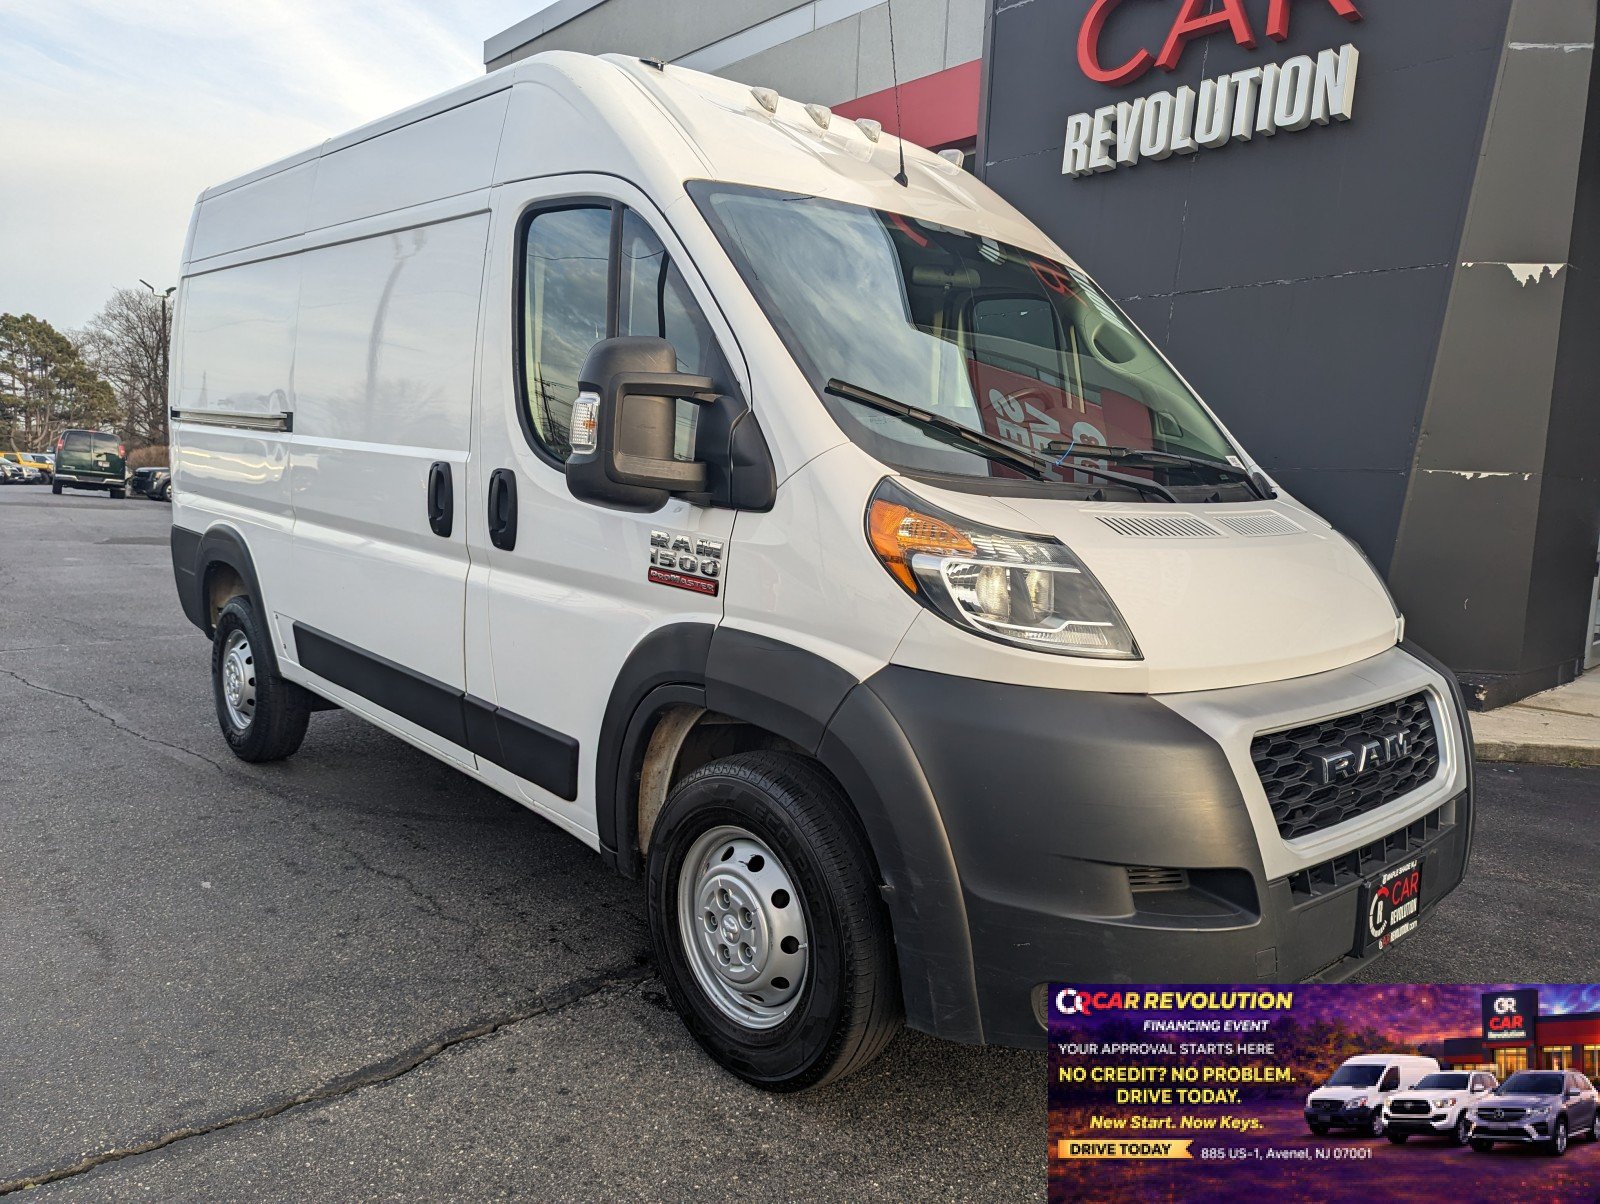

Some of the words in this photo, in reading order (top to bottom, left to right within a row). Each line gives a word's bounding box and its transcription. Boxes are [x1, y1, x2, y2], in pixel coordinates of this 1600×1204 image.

[1062, 43, 1360, 179] REVOLUTION
[649, 547, 721, 577] 1500
[650, 530, 724, 560] RAM
[1320, 729, 1413, 784] RAM
[1392, 871, 1419, 906] CAR
